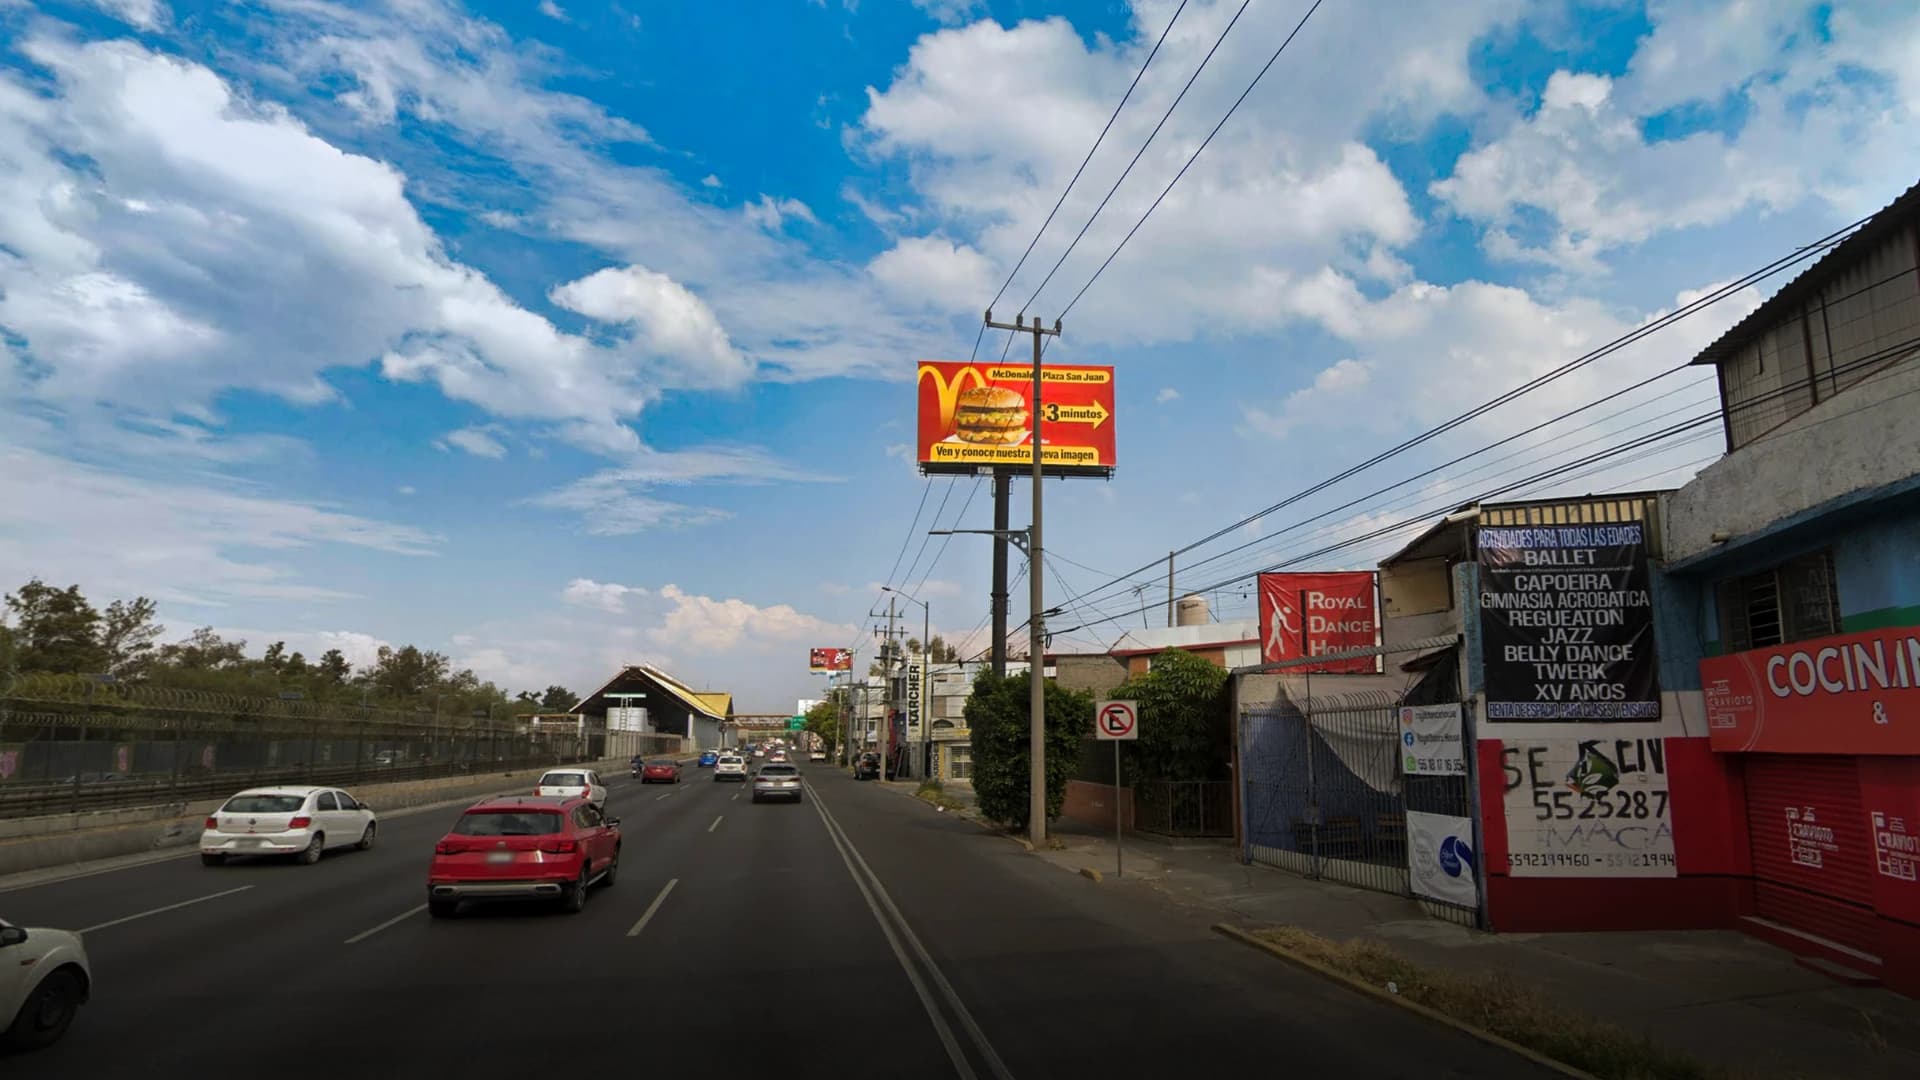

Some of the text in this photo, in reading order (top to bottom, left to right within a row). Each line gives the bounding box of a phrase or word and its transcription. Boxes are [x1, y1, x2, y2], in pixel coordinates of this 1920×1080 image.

[1042, 371, 1064, 381] Plaza
[1066, 372, 1082, 382] San
[1083, 372, 1104, 382] Juan
[1046, 403, 1060, 422] 3
[1060, 408, 1102, 419] minutos
[936, 446, 953, 456] Ven
[956, 448, 960, 458] y
[962, 448, 995, 457] conoce
[996, 449, 1030, 458] nuestra
[1061, 449, 1094, 462] imagen
[1534, 528, 1557, 547] PARA
[1559, 528, 1588, 546] TODAS
[1590, 527, 1610, 546] LAS
[1610, 525, 1641, 545] EDADES
[1524, 549, 1596, 566] BALLET
[1514, 574, 1612, 592] CAPOEIRA
[1480, 590, 1650, 609] GIMNASIA ACROBATICA
[1508, 609, 1624, 627] REGUEATON
[1540, 627, 1595, 645] JAZZ
[1504, 644, 1634, 662] BELLY DANCE
[1533, 663, 1607, 680] TWERK
[1535, 680, 1626, 701] XV AÑOS
[1872, 700, 1888, 724] &
[1500, 746, 1555, 792] SE
